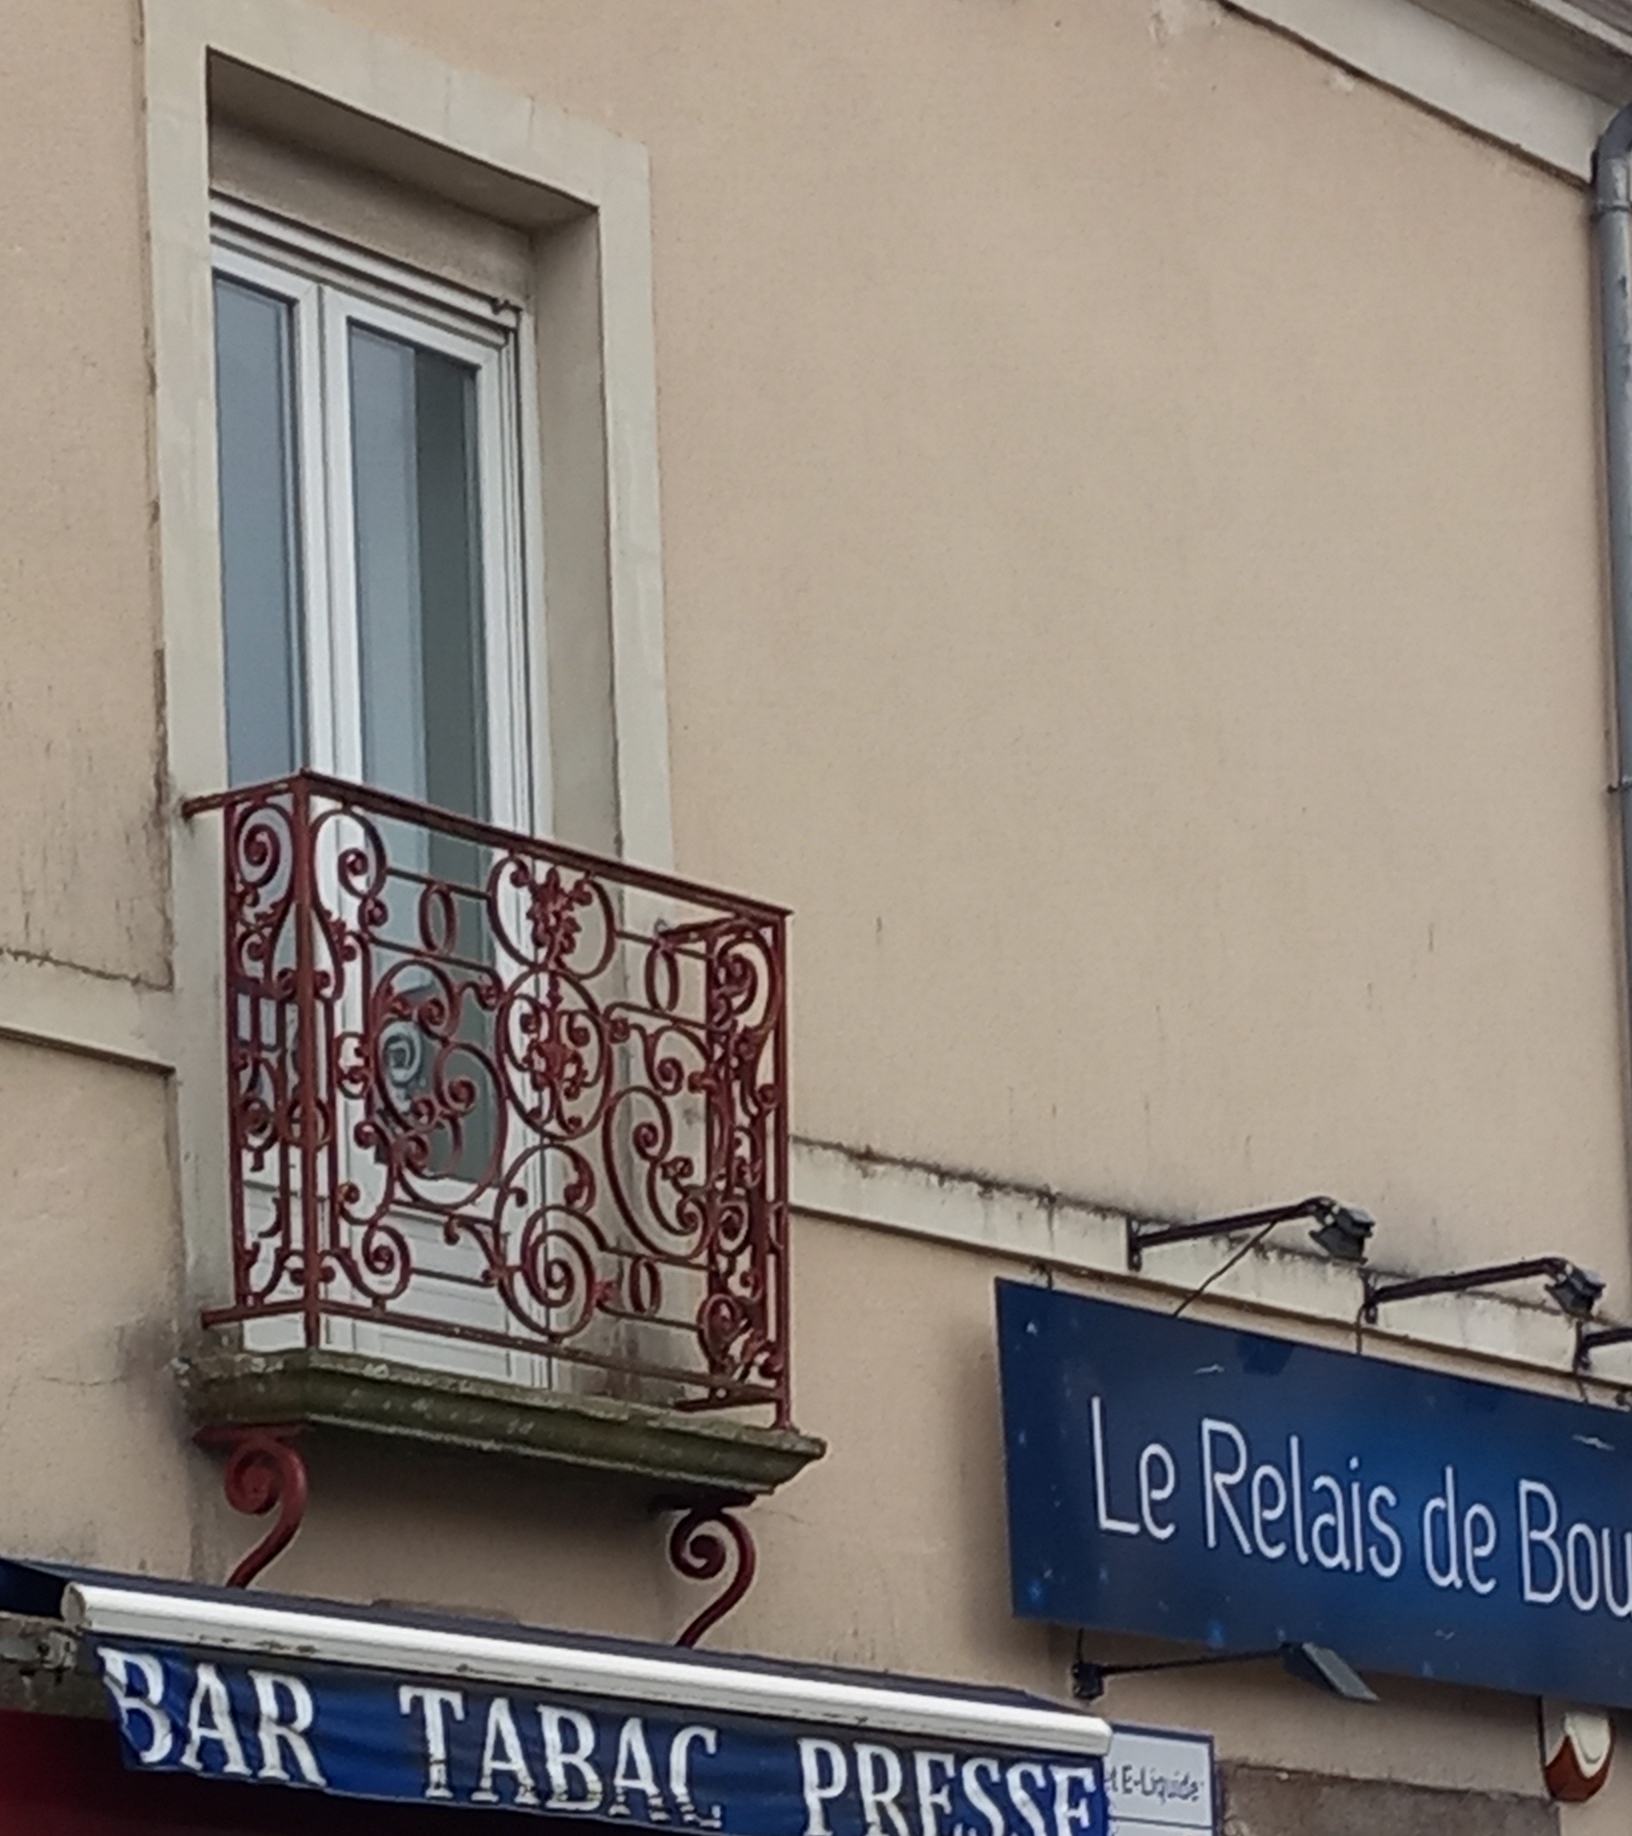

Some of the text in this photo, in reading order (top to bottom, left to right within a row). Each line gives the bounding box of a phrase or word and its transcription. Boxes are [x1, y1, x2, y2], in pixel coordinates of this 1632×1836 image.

[1091, 1396, 1177, 1542] Le
[1201, 1417, 1403, 1580] Relais
[1423, 1466, 1499, 1595] de
[96, 1645, 329, 1791] BAR
[398, 1682, 725, 1831] TABAC
